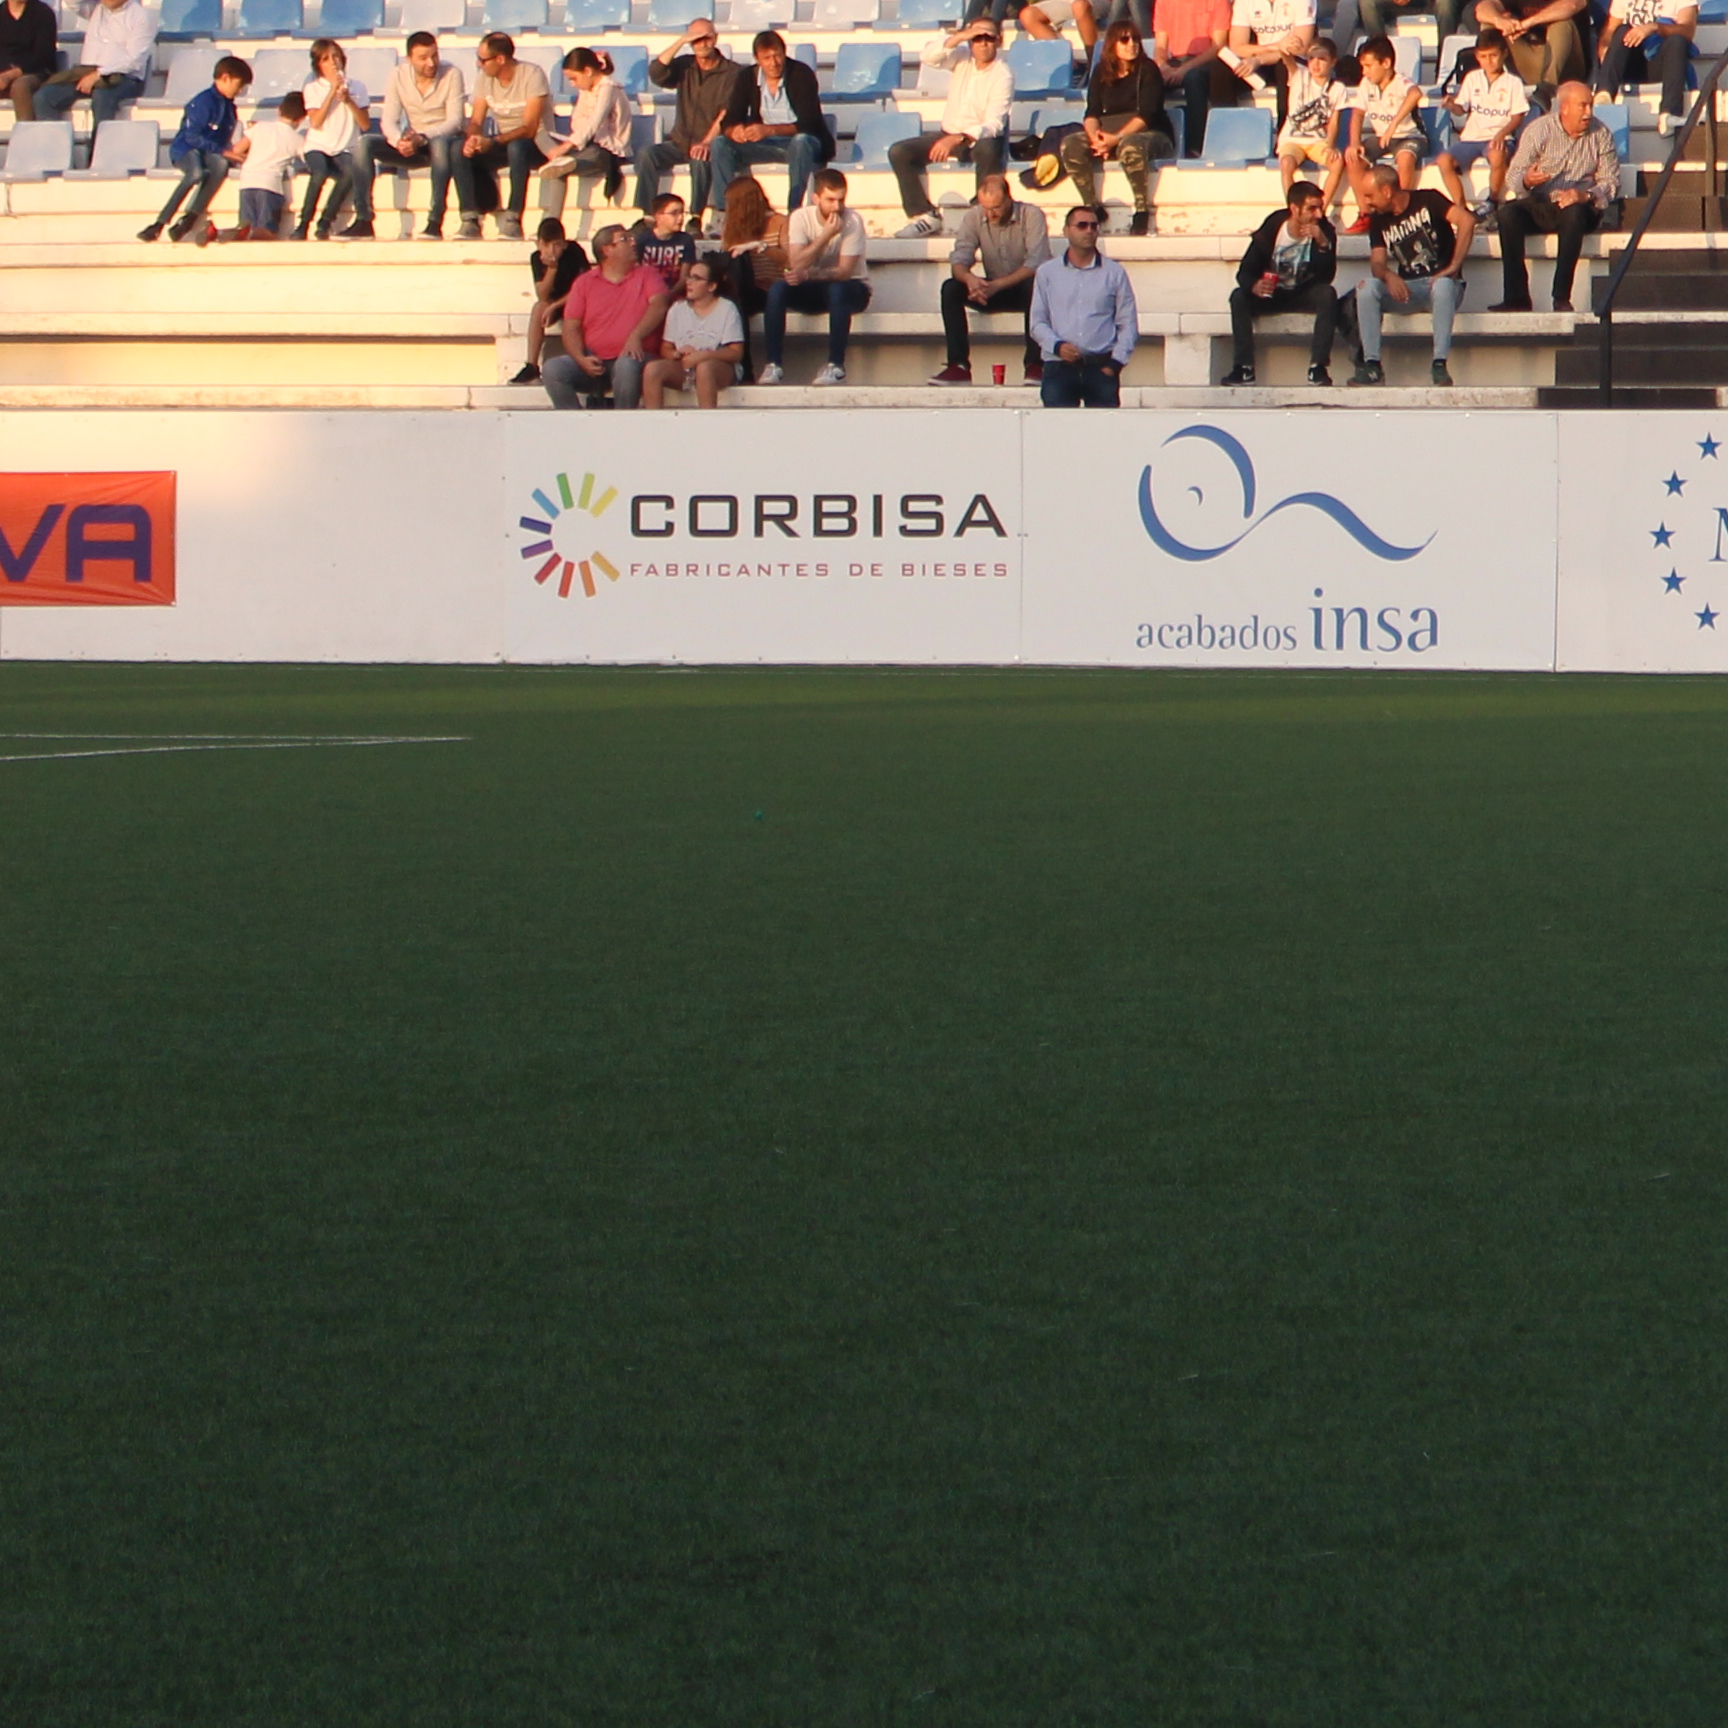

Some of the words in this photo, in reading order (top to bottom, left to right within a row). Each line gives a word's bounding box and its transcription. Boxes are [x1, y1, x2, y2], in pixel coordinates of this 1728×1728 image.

[1382, 208, 1431, 246] WAITING
[630, 493, 1008, 539] CORBISA
[630, 562, 829, 578] FABRICANTES
[849, 562, 883, 577] DE
[901, 562, 1008, 577] BIESES
[1135, 614, 1298, 651] acabados
[1308, 587, 1439, 653] insa
